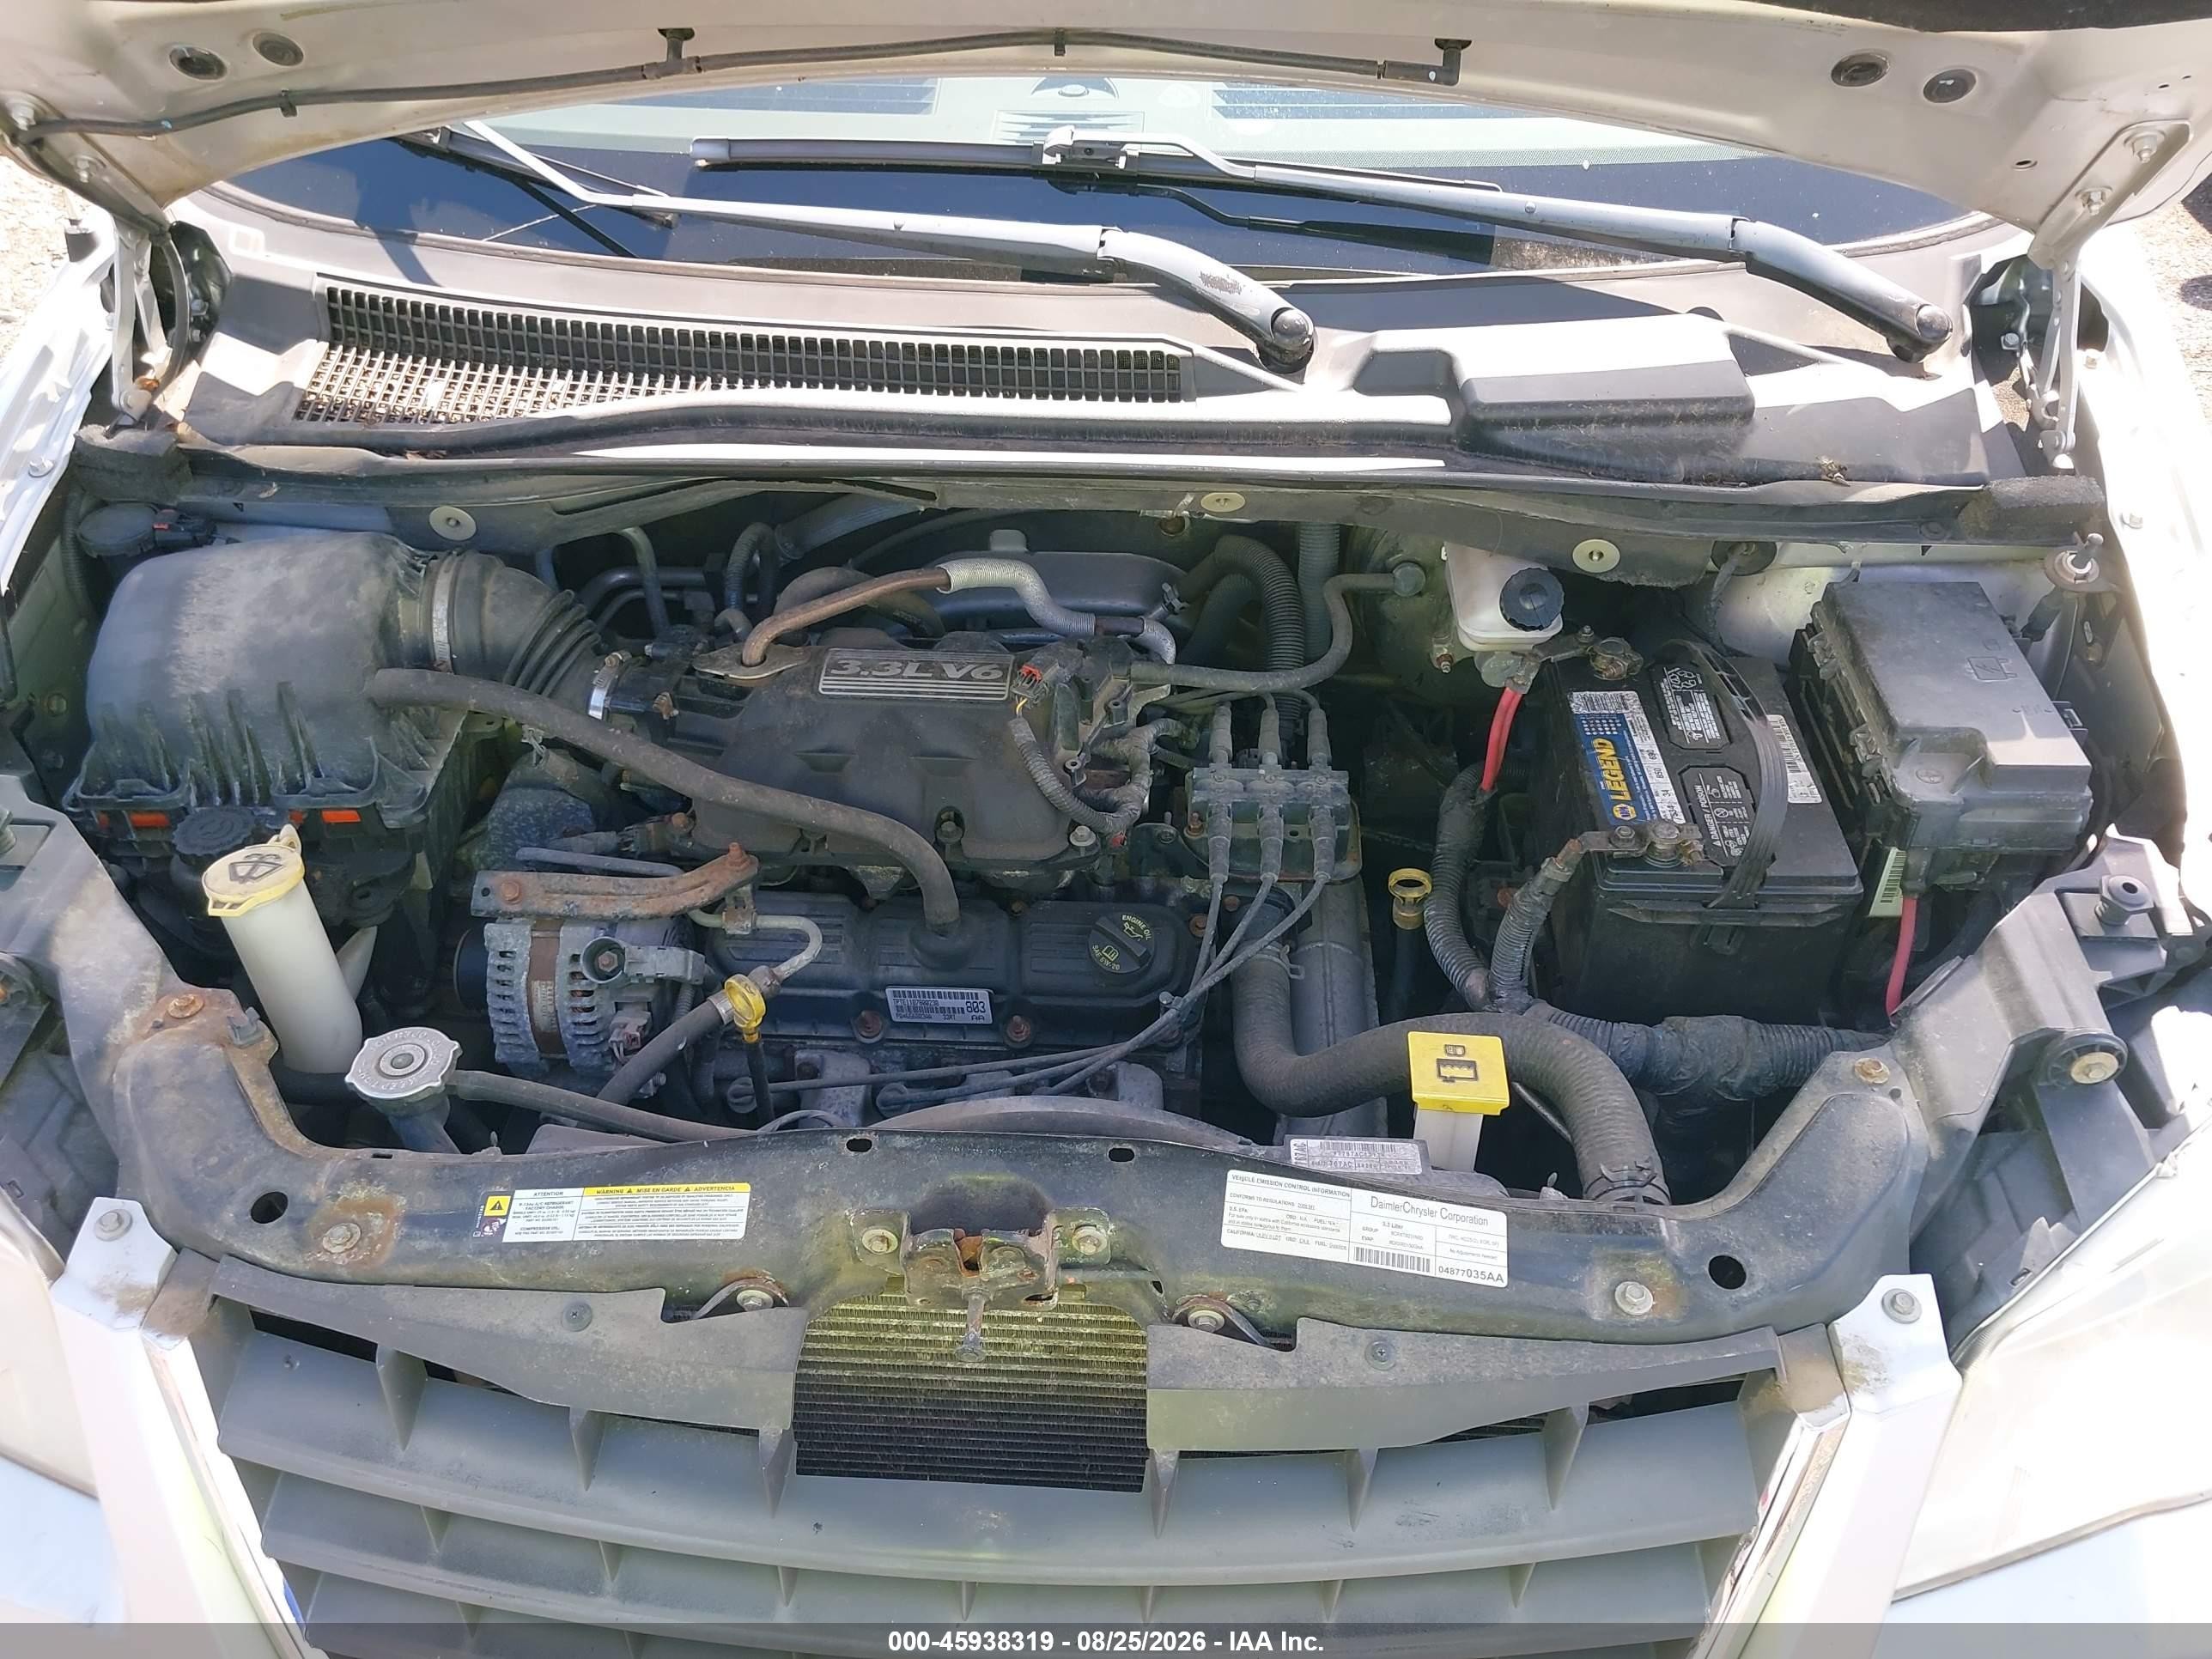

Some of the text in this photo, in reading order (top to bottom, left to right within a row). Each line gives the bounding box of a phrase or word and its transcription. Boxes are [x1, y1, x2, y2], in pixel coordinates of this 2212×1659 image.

[831, 659, 1003, 680] 3.3L V6
[1593, 738, 1632, 801] LEGEND
[1694, 785, 1709, 807] POISON
[1705, 814, 1720, 840] DANGER
[1122, 915, 1146, 929] ENGINE
[965, 1001, 986, 1013] 803
[1232, 1174, 1350, 1198] VEHICLE EMISSION CONTROL INFORMATION
[1370, 1196, 1489, 1226] DaimlerChrysler Corporation
[1438, 1266, 1504, 1283] 04877035AA
